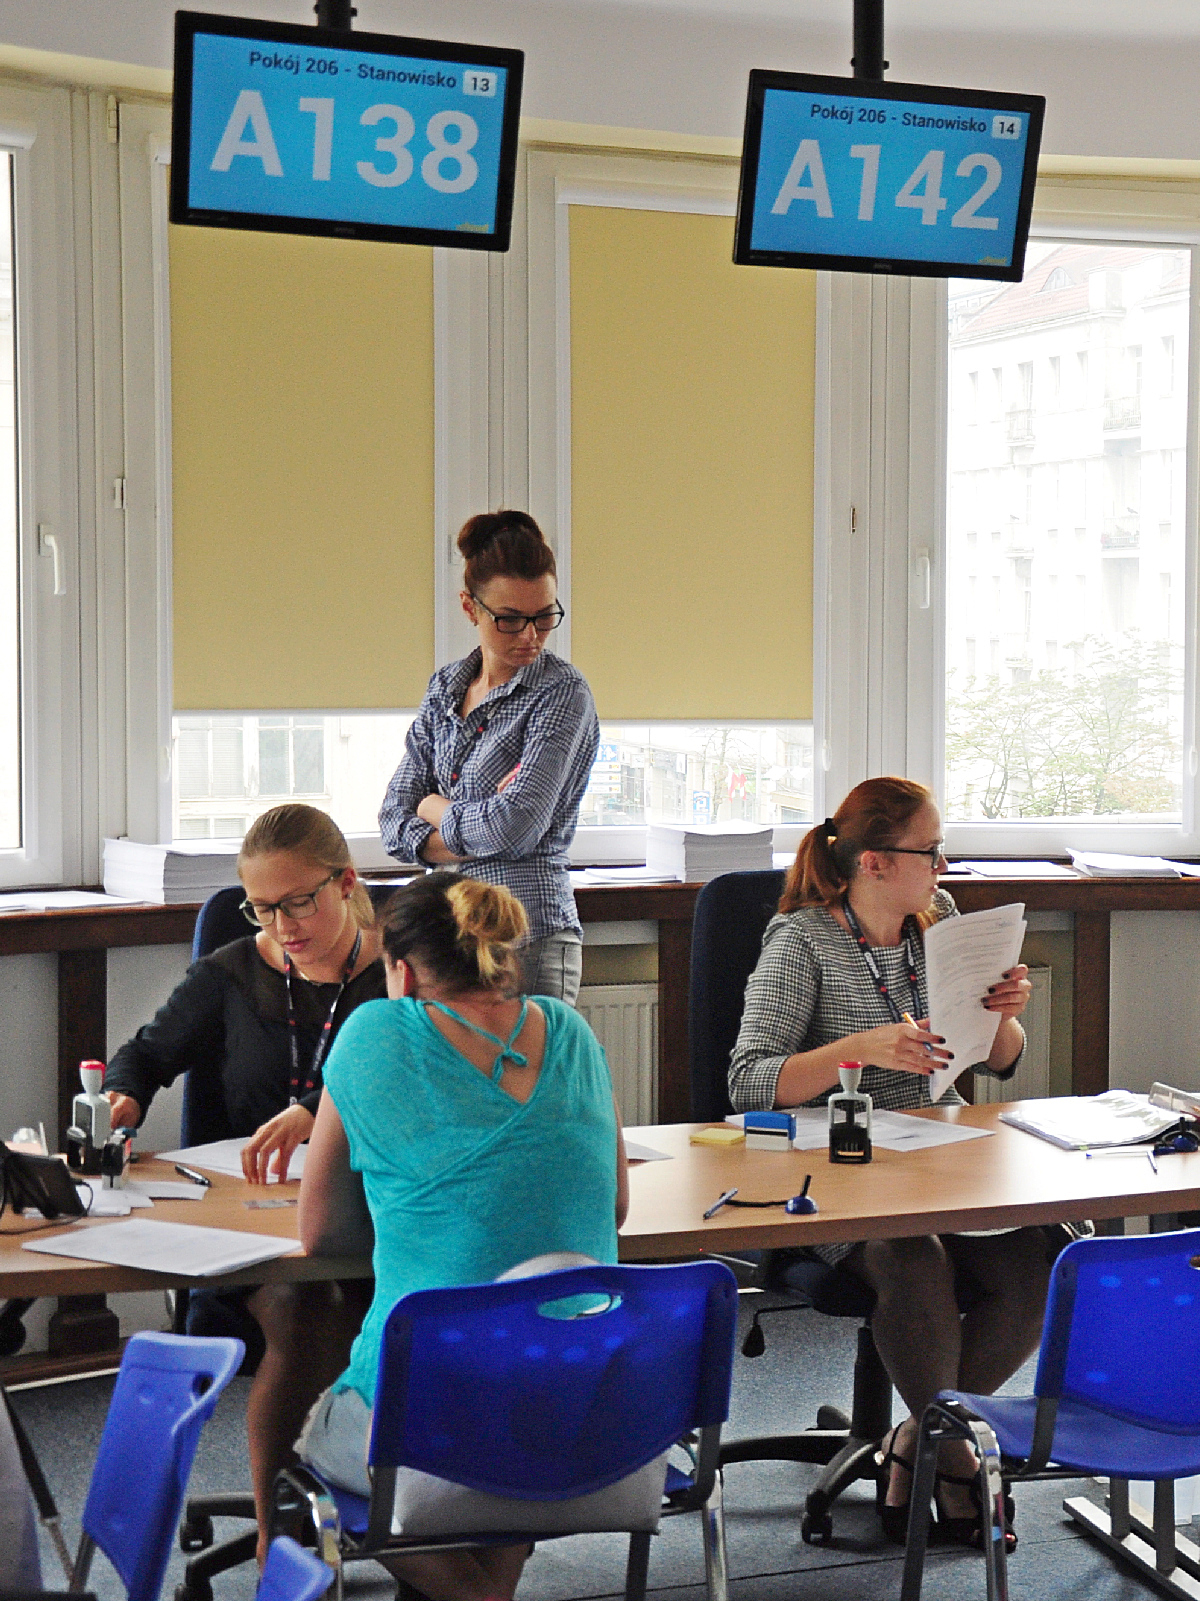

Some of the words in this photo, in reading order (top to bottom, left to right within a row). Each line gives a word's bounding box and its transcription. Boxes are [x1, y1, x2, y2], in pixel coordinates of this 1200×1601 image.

[249, 51, 300, 75] Pokój
[306, 58, 339, 76] 206
[357, 63, 457, 88] Stanowisko
[470, 76, 490, 92] 13
[209, 89, 480, 194] A138
[810, 104, 853, 125] Pokój
[857, 108, 887, 125] 206
[901, 112, 987, 133] Stanowisko
[998, 121, 1016, 135] 14
[770, 139, 1002, 231] A142
